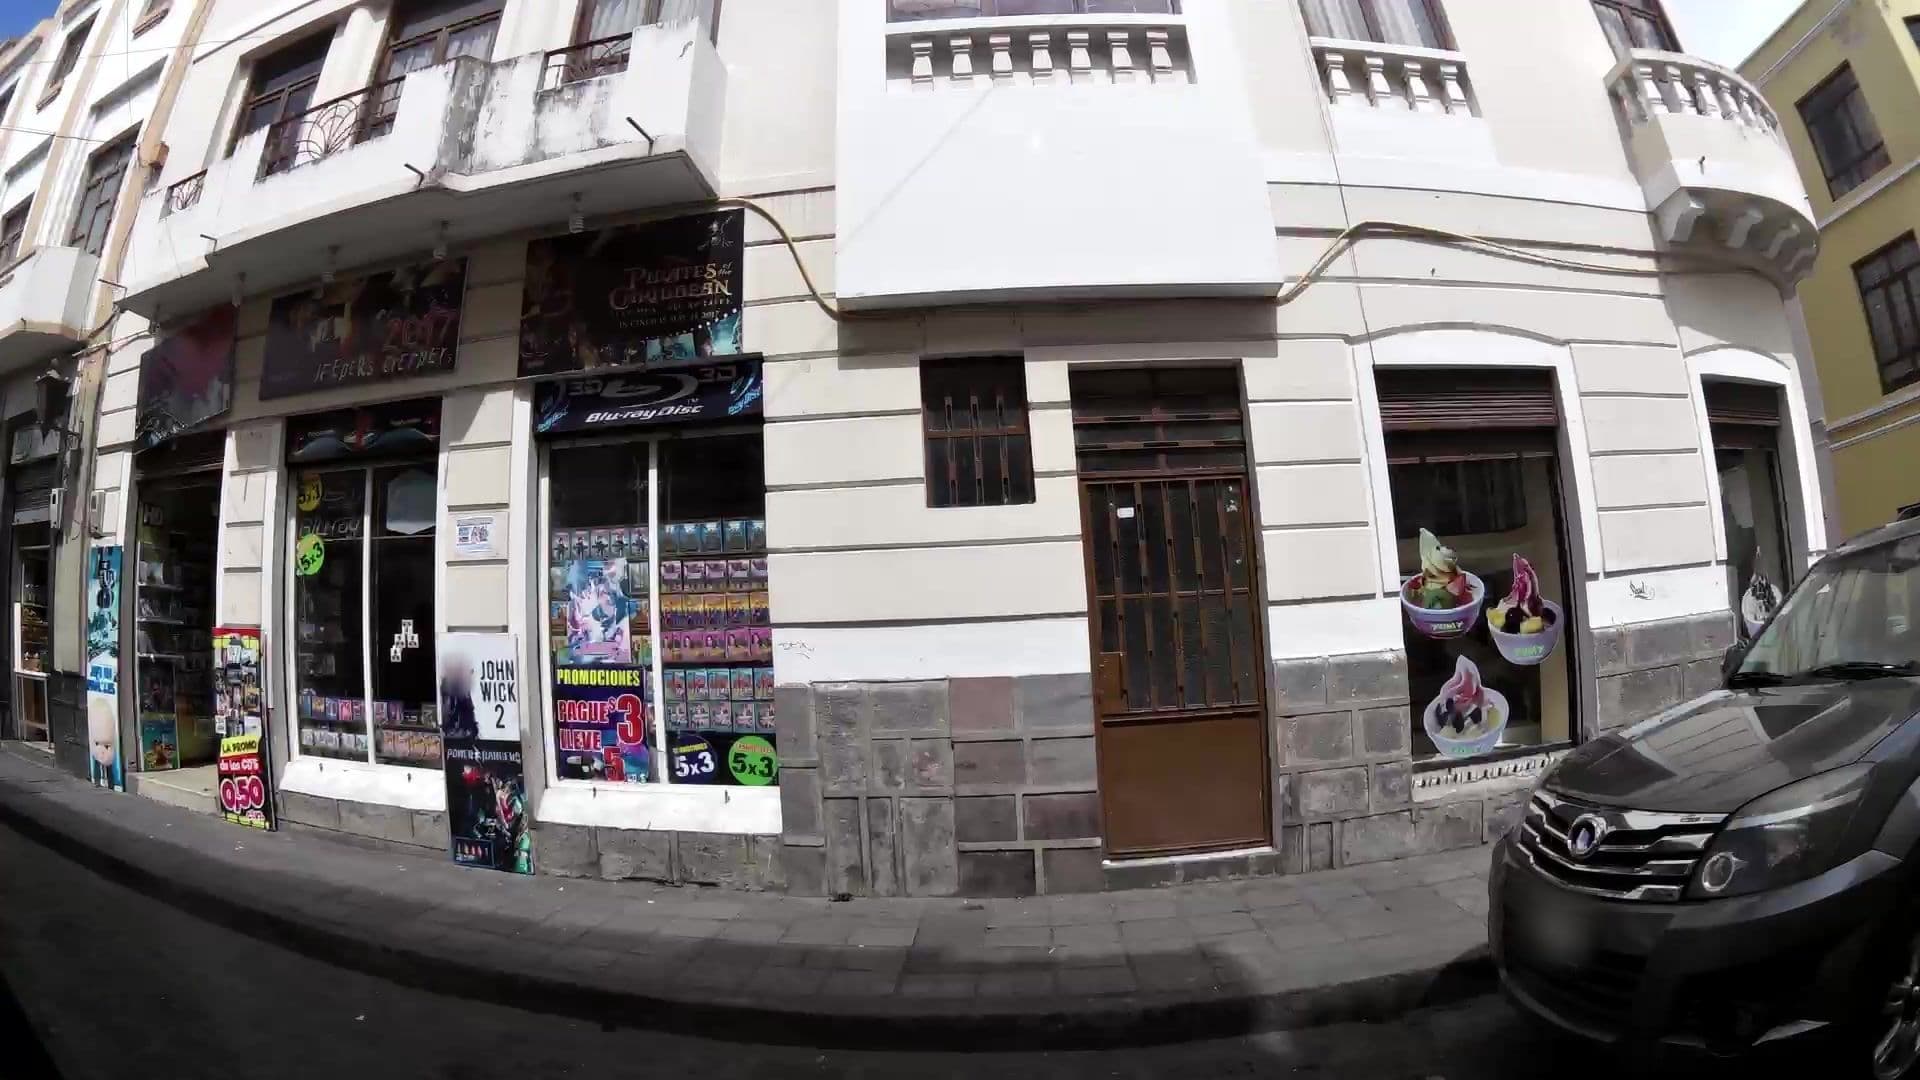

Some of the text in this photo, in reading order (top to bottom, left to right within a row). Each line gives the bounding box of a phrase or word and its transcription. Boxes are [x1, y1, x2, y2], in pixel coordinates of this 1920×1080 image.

[479, 659, 515, 681] JOHN
[556, 668, 641, 688] PROMOCIONES
[479, 682, 517, 703] WICK
[494, 704, 506, 730] 2
[557, 699, 610, 724] PAGUE
[232, 740, 257, 753] PROMO
[559, 728, 626, 782] LLEVE 5
[673, 751, 715, 777] 5x3
[731, 752, 775, 778] 5x3
